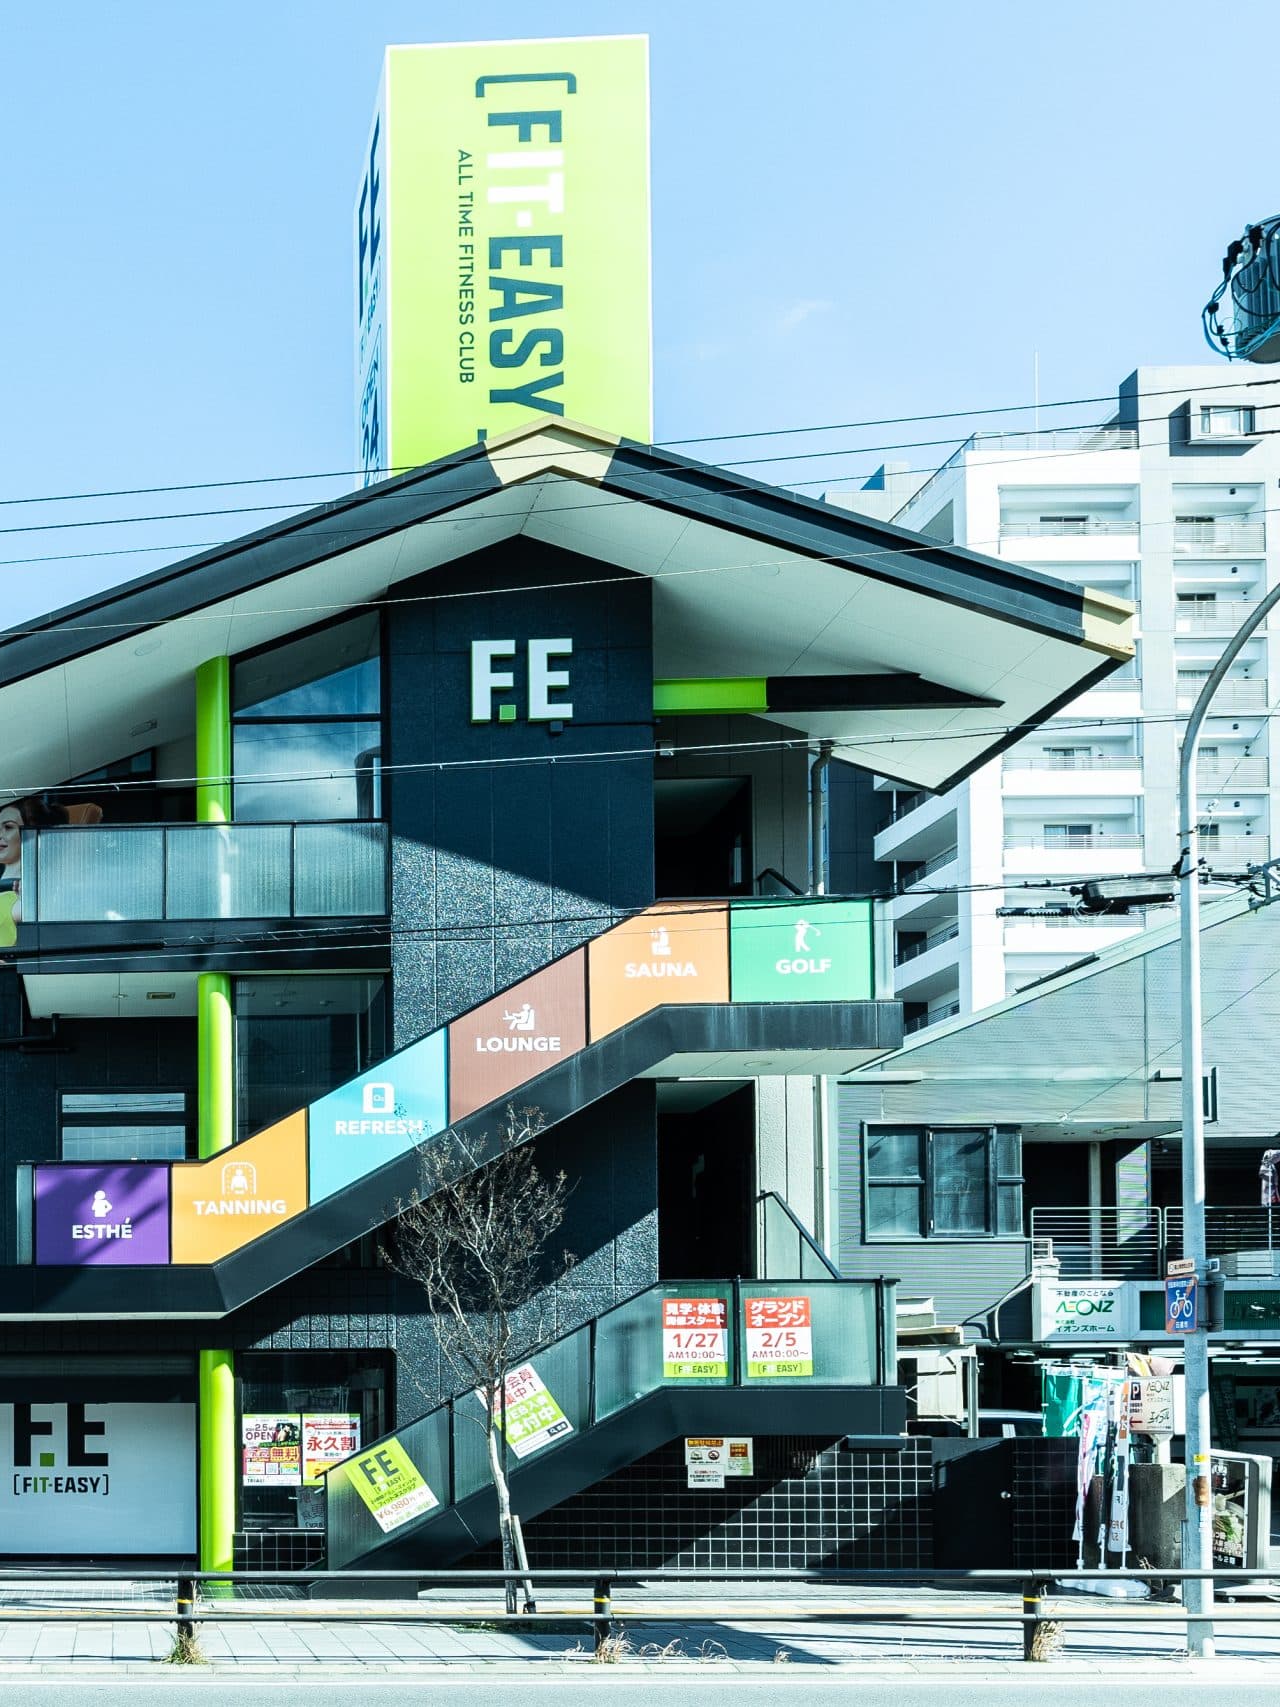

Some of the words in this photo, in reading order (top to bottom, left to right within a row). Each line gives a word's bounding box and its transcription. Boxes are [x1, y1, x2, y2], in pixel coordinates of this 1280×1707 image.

[457, 149, 473, 185] ALL
[458, 191, 474, 237] TIME
[458, 244, 475, 325] FITNESS
[459, 331, 475, 384] CLUB
[624, 962, 698, 978] SAUNA
[775, 957, 832, 975] GOLF
[476, 1036, 561, 1053] LOUNGE
[335, 1120, 424, 1136] REFRESH
[193, 1199, 286, 1216] TANNING
[72, 1219, 133, 1240] ESTHÉ
[751, 1300, 805, 1314] グランド
[751, 1314, 806, 1327] オープン
[673, 1332, 719, 1348] 1/27
[761, 1332, 797, 1348] 2/5
[245, 1432, 274, 1441] OPEN
[307, 1436, 357, 1451] 永久割
